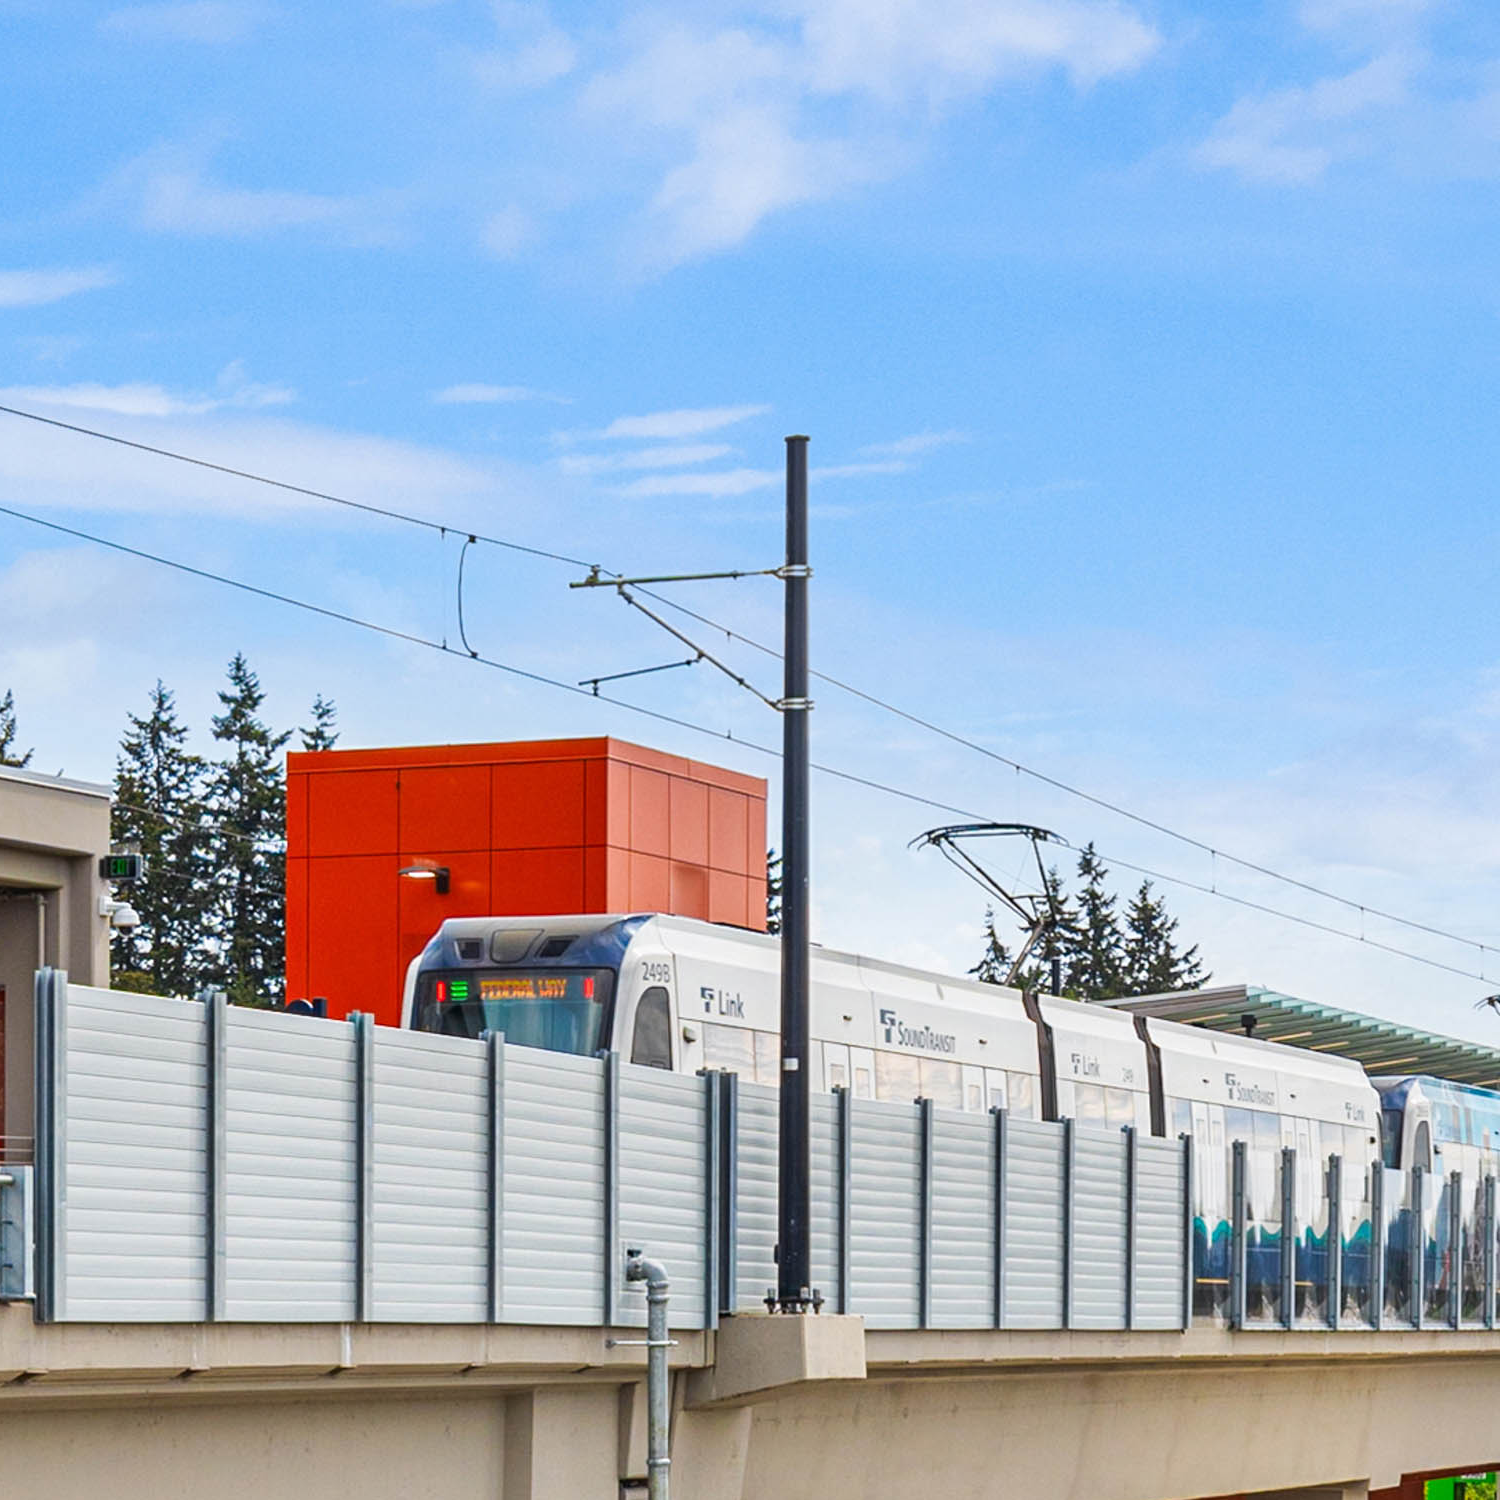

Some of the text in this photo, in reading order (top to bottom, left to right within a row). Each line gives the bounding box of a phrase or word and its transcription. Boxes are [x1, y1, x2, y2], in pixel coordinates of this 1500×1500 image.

[480, 978, 567, 999] FEDERAL WAY
[719, 989, 744, 1019] Link
[1083, 1055, 1100, 1077] Link
